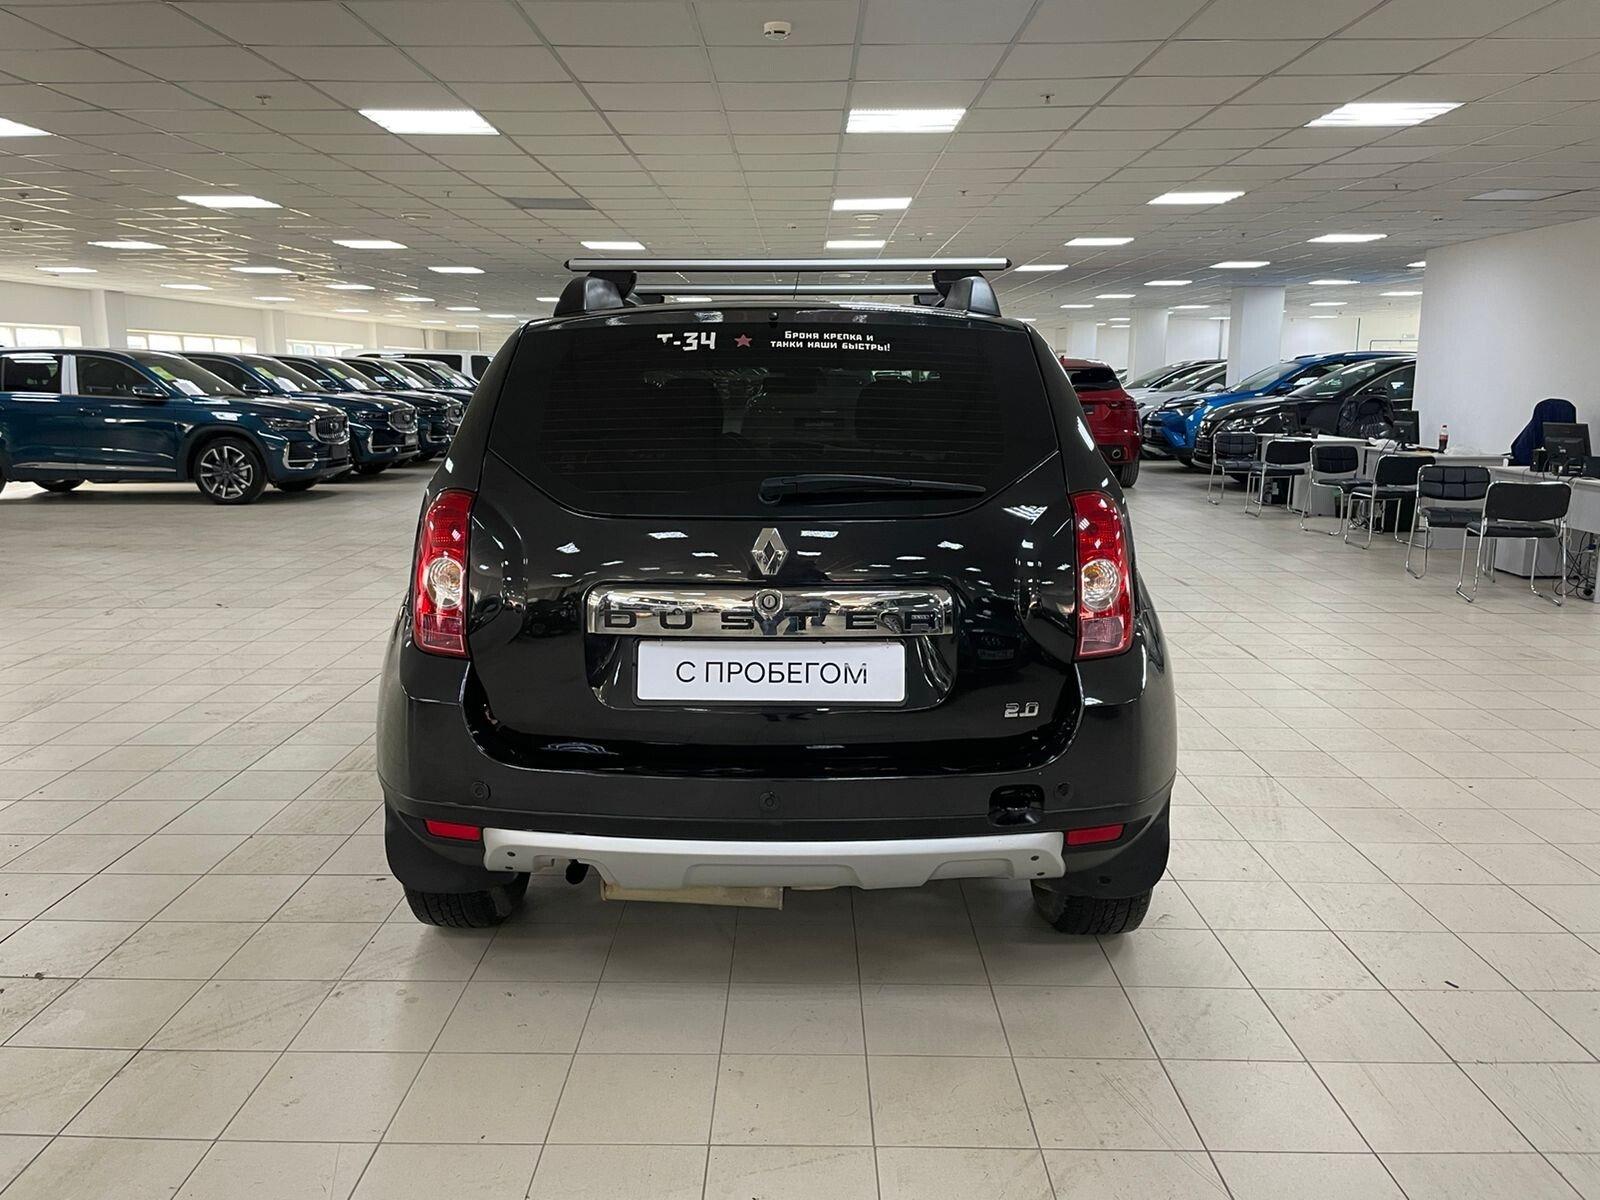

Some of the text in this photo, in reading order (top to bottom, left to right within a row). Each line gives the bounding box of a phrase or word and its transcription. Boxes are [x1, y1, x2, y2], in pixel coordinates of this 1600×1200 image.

[603, 609, 937, 631] DUSTER
[675, 661, 868, 685] С ПРОБЕГОМ
[1003, 701, 1040, 718] 2.0
